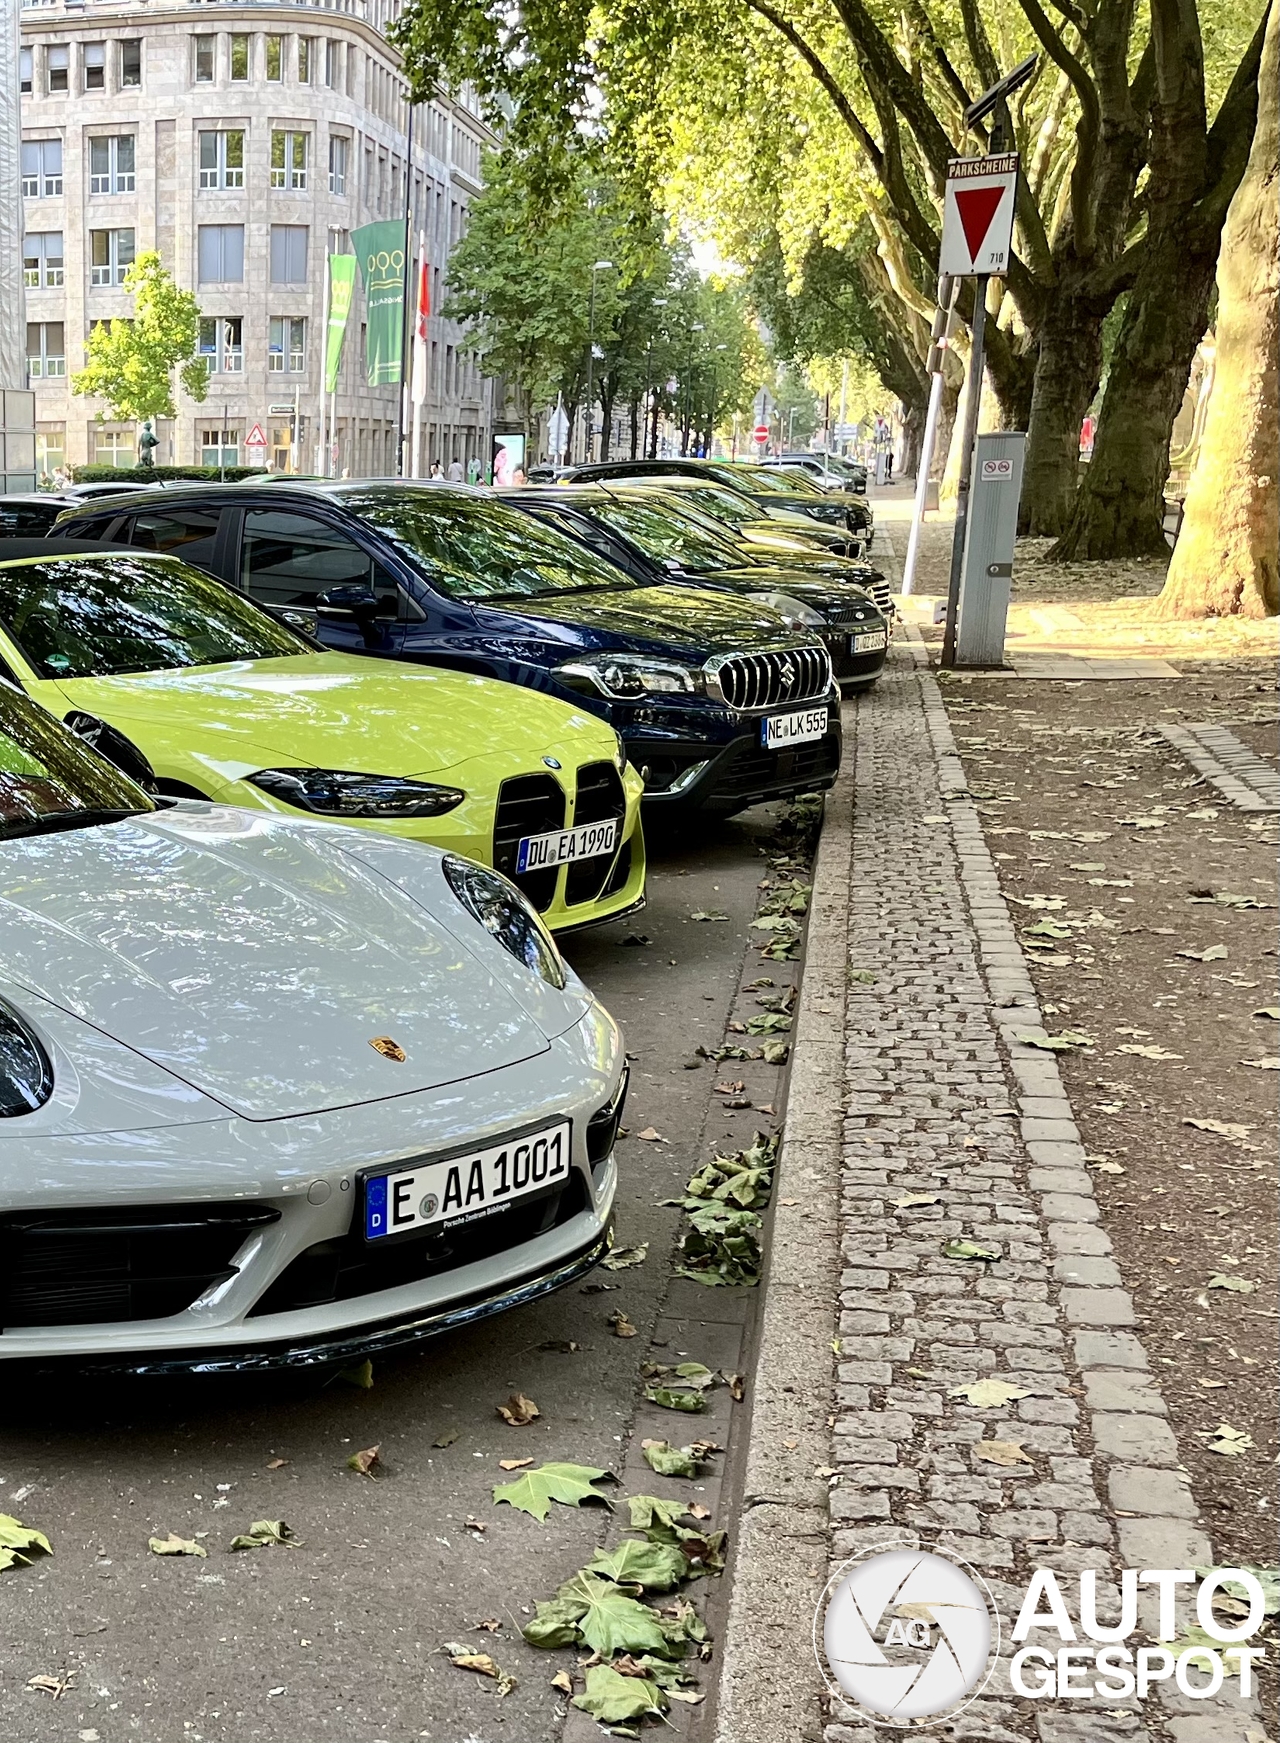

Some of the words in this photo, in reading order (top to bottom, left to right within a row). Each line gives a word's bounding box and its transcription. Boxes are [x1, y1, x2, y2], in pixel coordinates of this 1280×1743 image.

[949, 157, 1016, 178] PARKSCHEINE
[990, 253, 1004, 264] 710
[768, 719, 782, 740] NE
[790, 715, 804, 736] LK
[807, 711, 826, 733] 555
[528, 840, 548, 867] DU
[558, 834, 576, 860] EA
[579, 826, 613, 855] 1990
[393, 1177, 416, 1226] E
[442, 1160, 486, 1213] AA
[493, 1132, 565, 1197] 1001
[371, 1213, 381, 1228] D
[443, 1217, 465, 1229] Porsche
[465, 1210, 487, 1223] Zentrum
